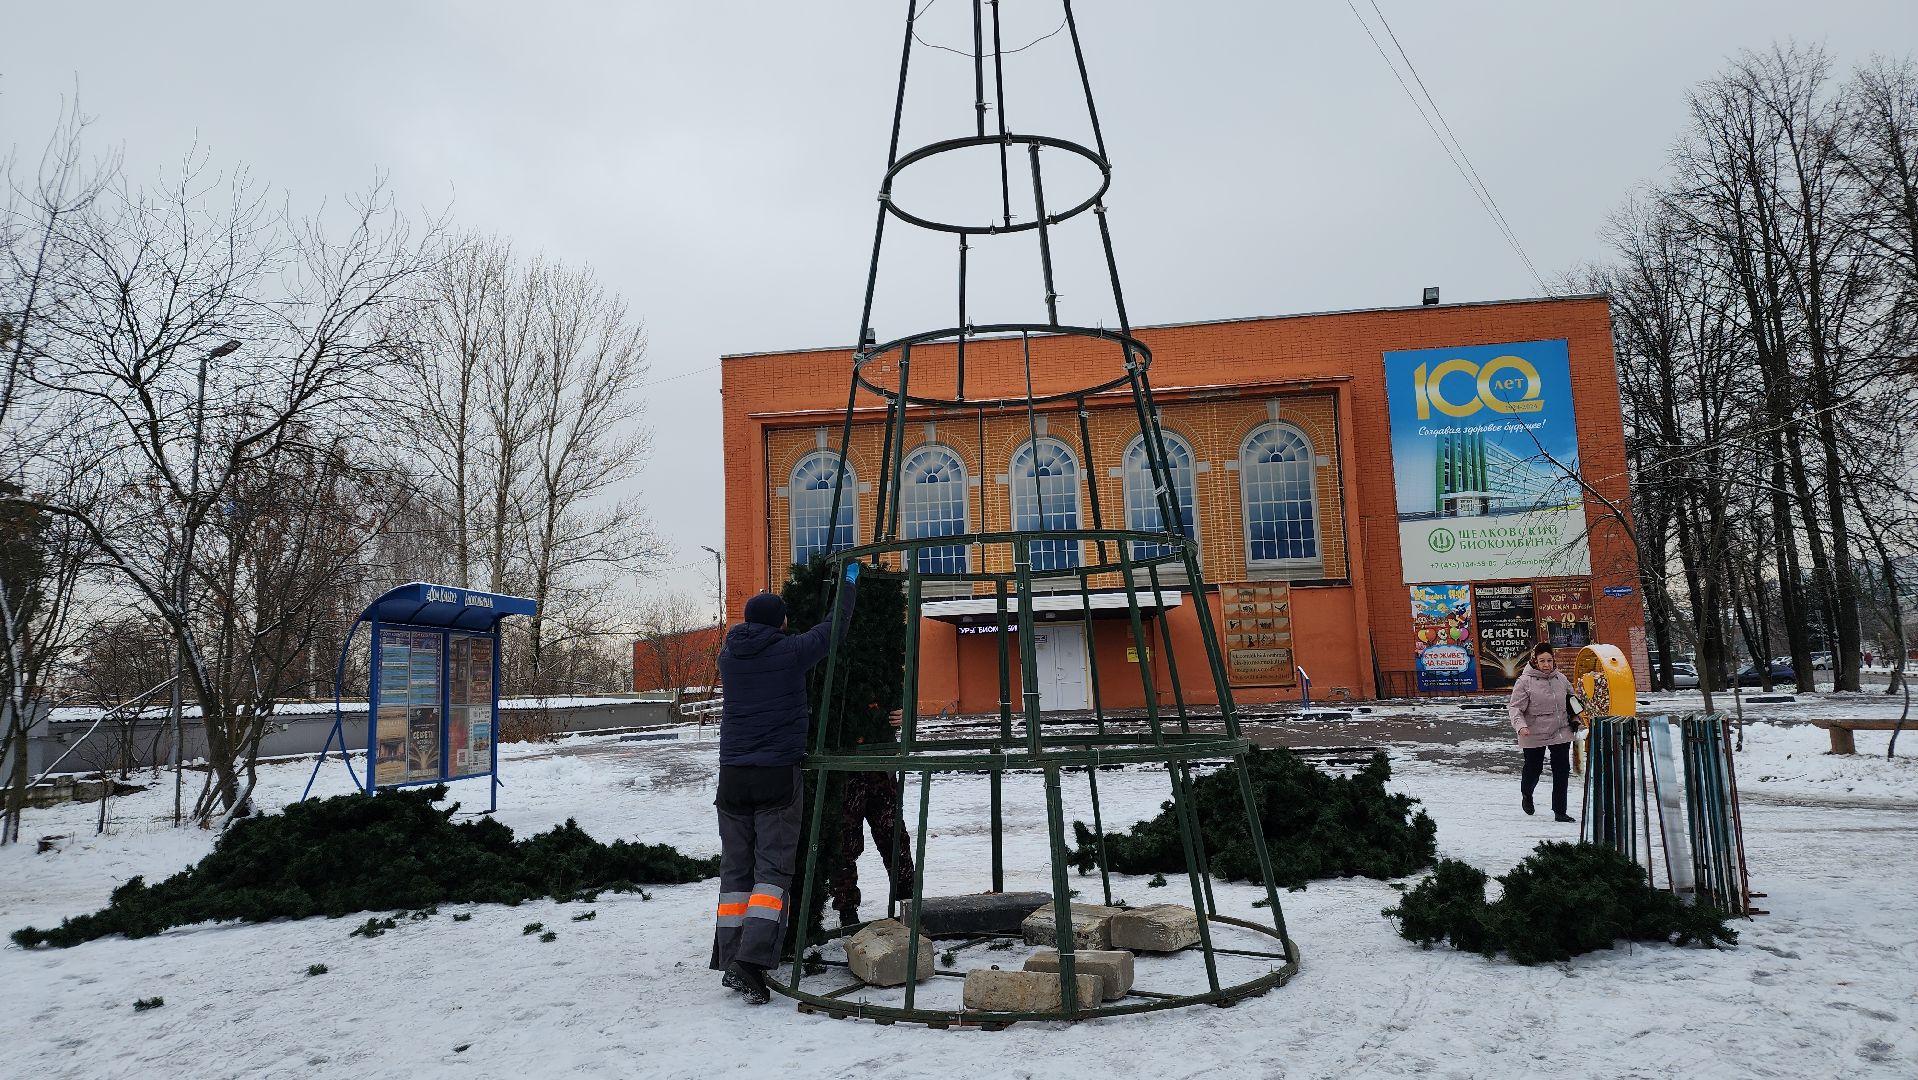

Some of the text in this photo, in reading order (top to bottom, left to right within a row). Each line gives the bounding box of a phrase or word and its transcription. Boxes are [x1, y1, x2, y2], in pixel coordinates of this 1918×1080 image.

[1414, 356, 1544, 420] 100
[1418, 424, 1461, 437] Создавая
[1462, 424, 1502, 434] здоровое
[1460, 536, 1561, 550] БИОКОМБИНАТ
[1550, 593, 1567, 602] ХОР
[1561, 612, 1576, 623] 70
